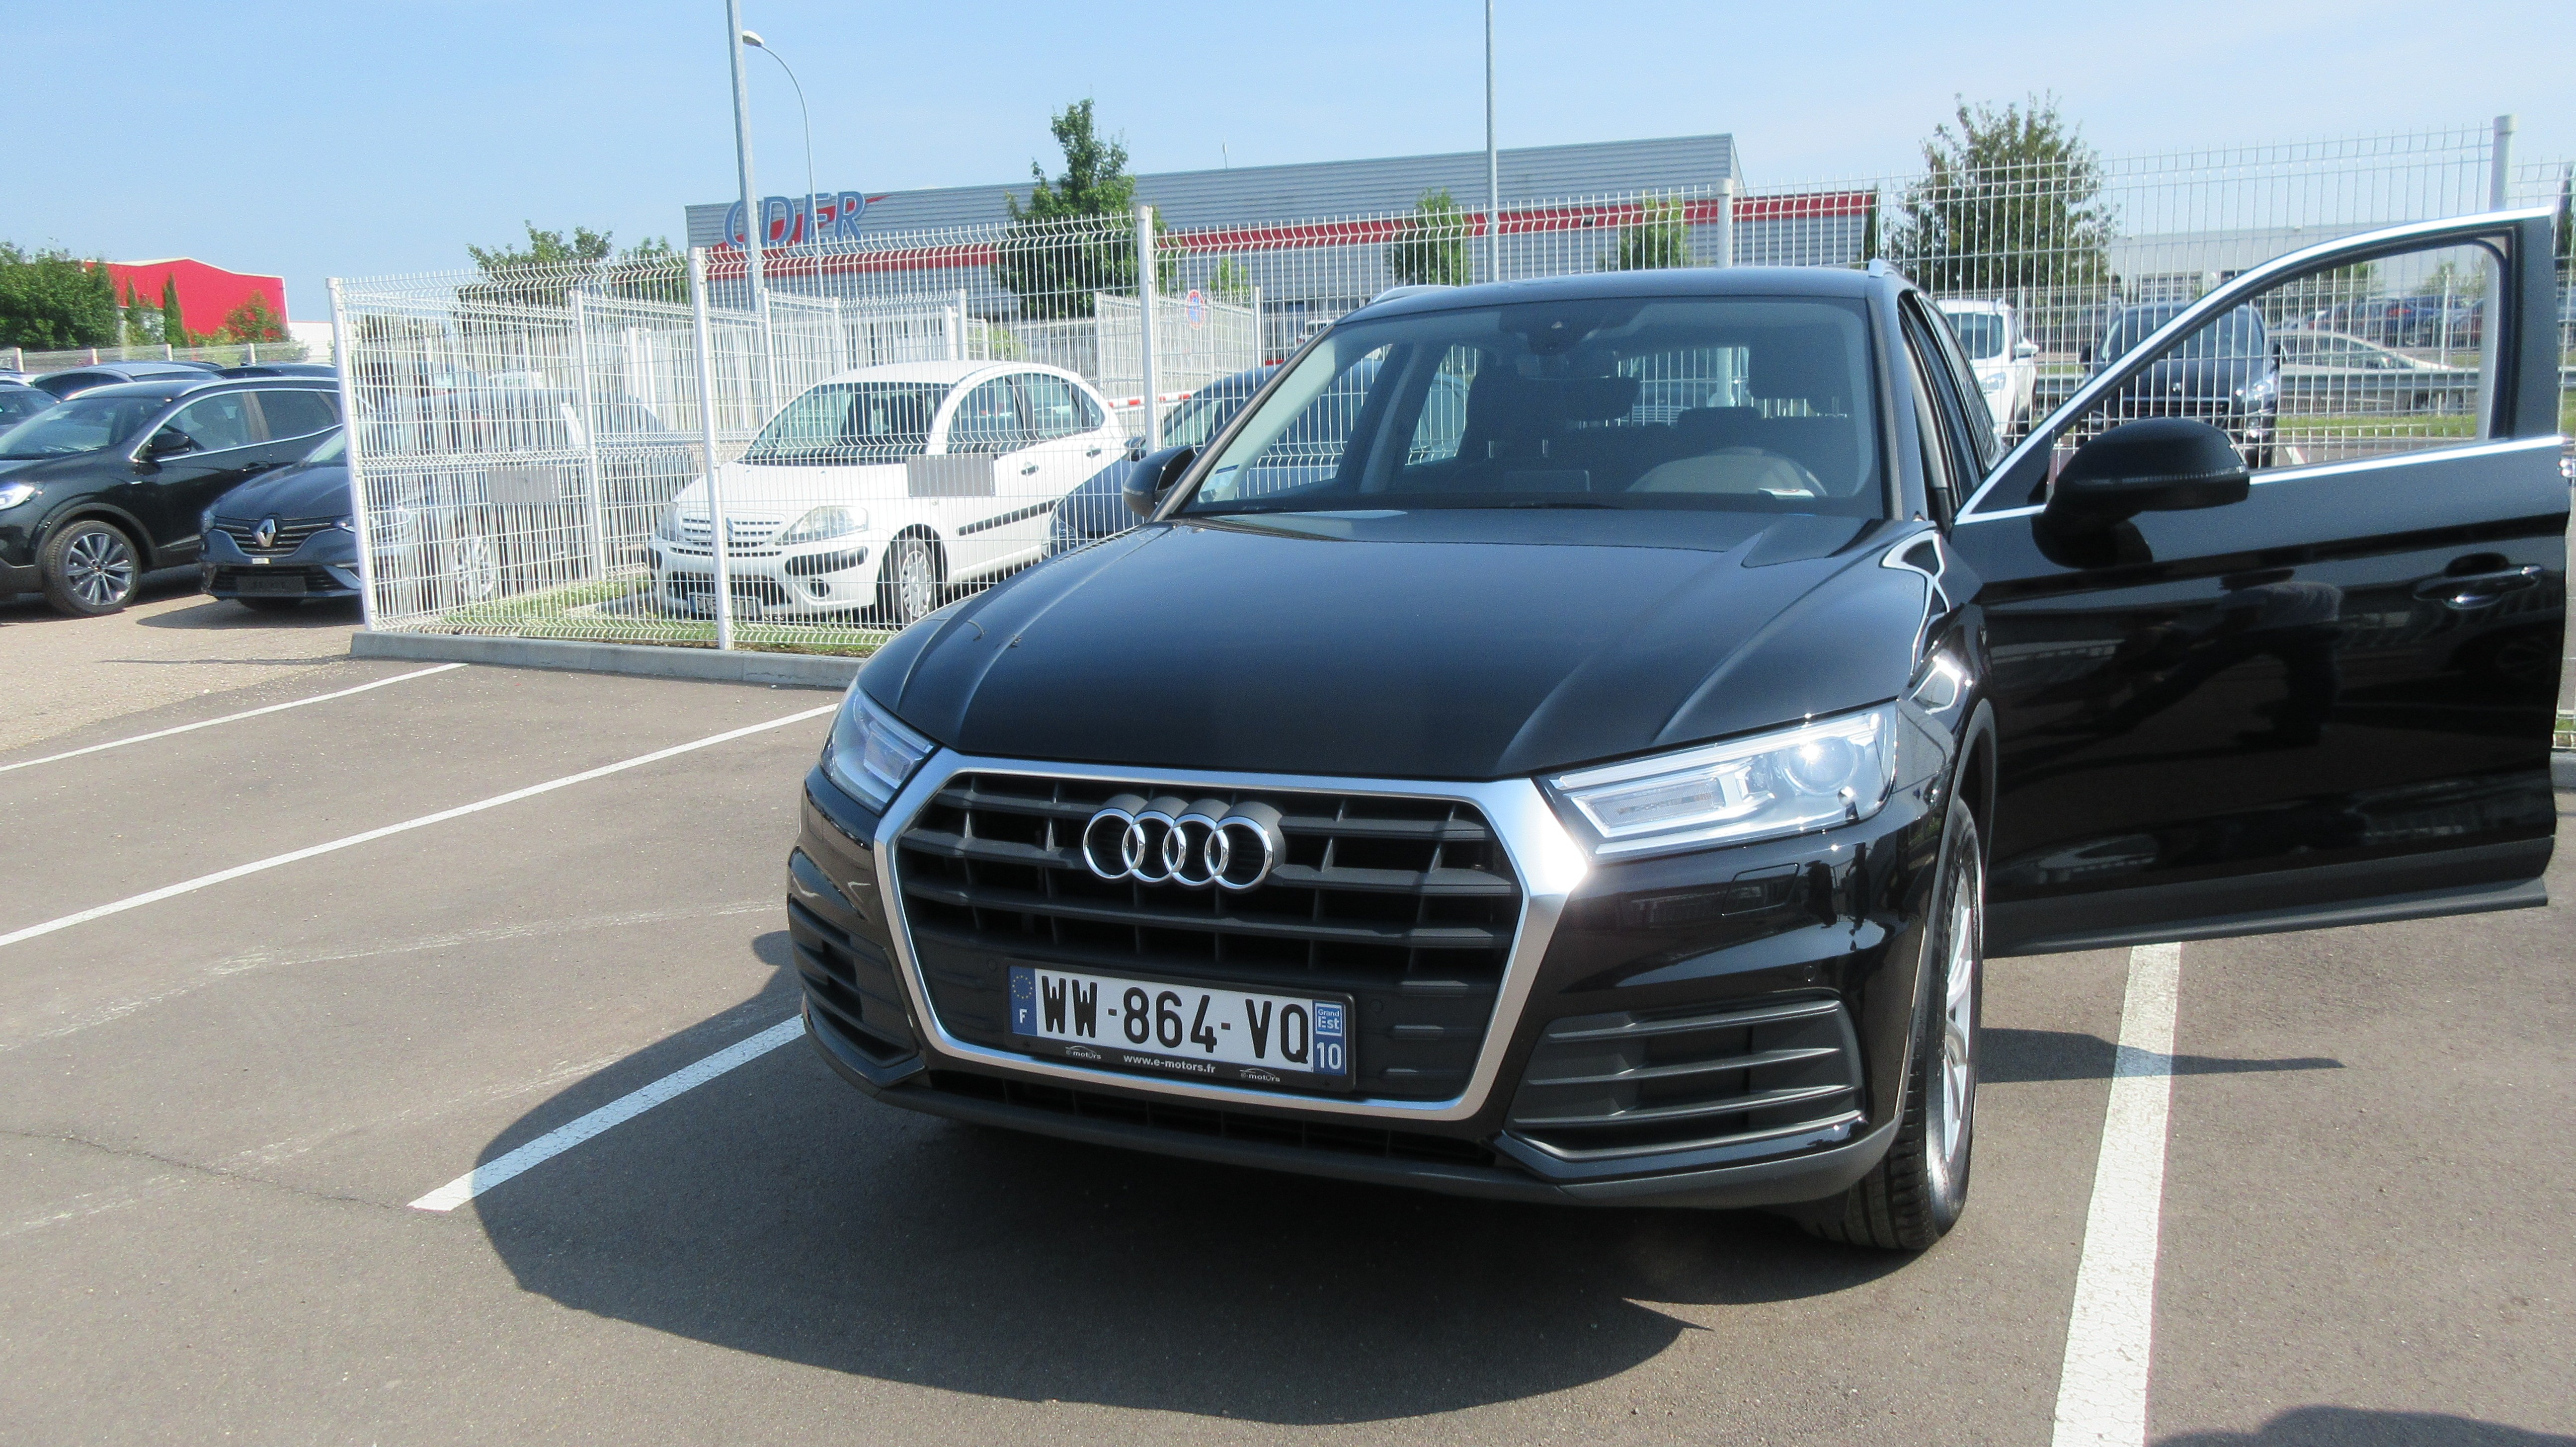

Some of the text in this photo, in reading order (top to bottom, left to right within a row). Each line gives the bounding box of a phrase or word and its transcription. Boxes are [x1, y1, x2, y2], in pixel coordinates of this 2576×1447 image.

[1019, 1009, 1027, 1024] F
[1042, 975, 1308, 1064] WW-864-VQ
[1318, 1016, 1340, 1029] Est
[1123, 1054, 1216, 1073] www.e-motors.fr
[1317, 1042, 1342, 1070] 10
